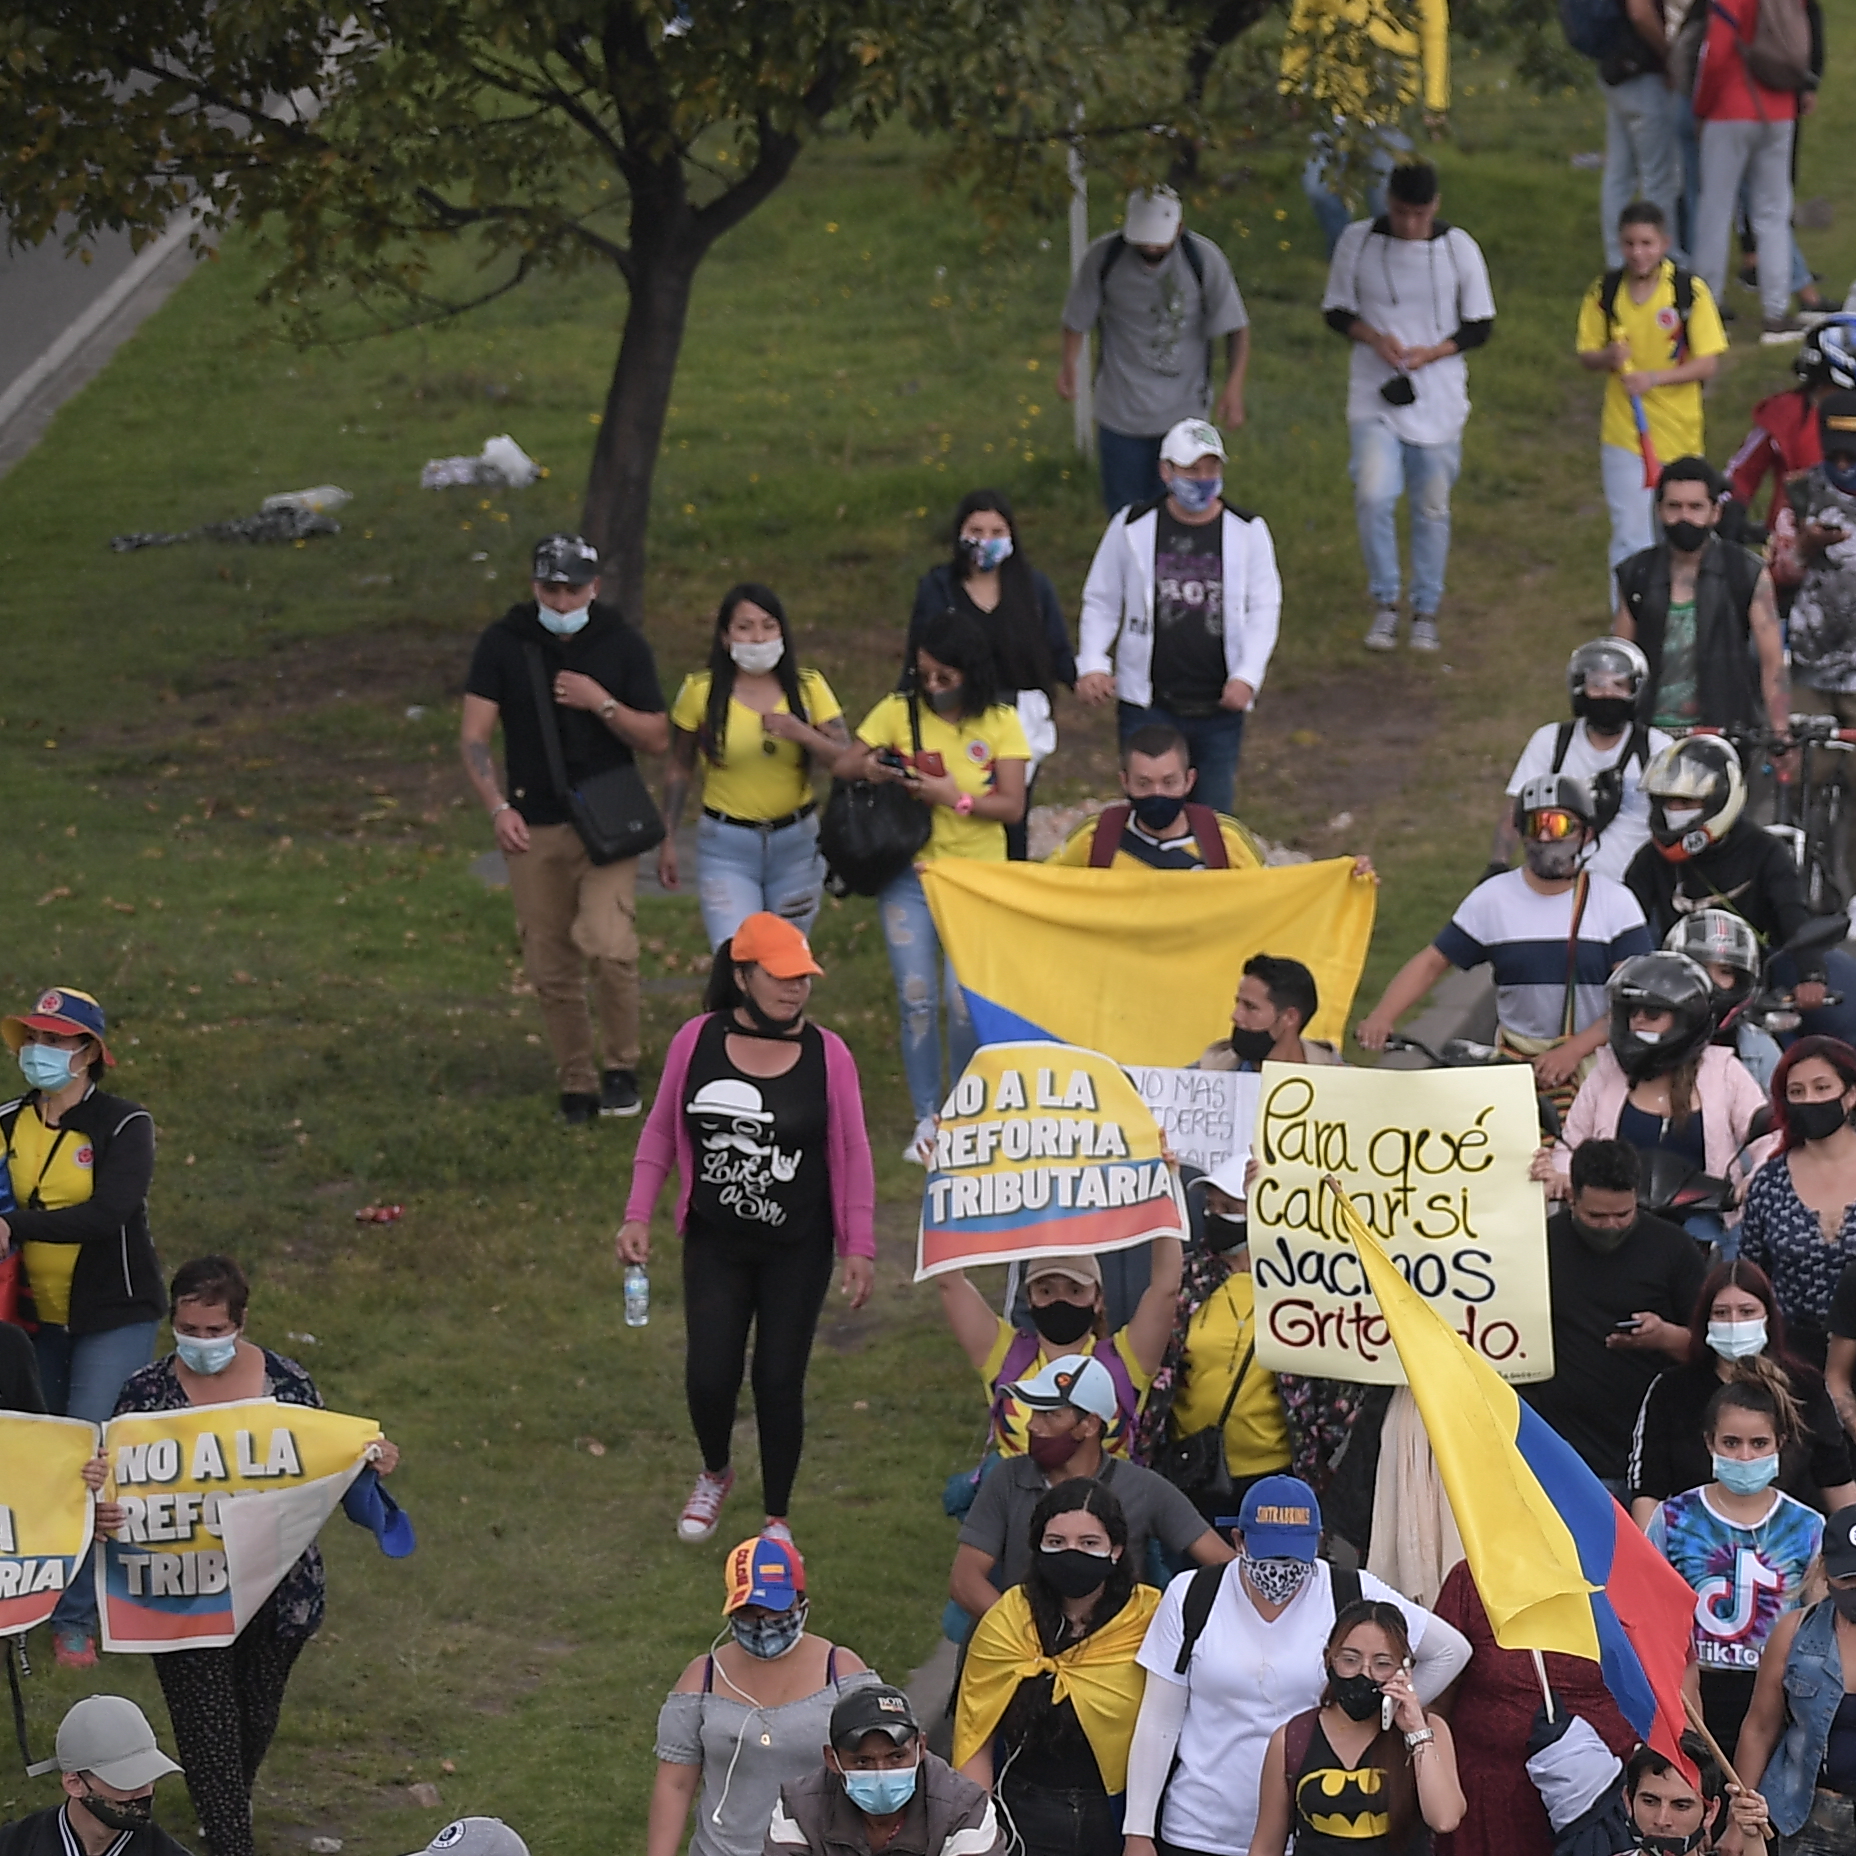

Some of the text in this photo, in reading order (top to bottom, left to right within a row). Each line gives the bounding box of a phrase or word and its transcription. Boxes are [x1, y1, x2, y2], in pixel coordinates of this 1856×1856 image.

[993, 1070, 1025, 1109] A
[1036, 1068, 1096, 1110] LA
[1173, 1070, 1227, 1108] MAS
[930, 1117, 1126, 1171] REFORMA
[1262, 1076, 1496, 1218] Para qué
[928, 1161, 1173, 1224] TRIBUTARIA
[1413, 1186, 1478, 1239] si
[116, 1428, 300, 1484] NO A LA
